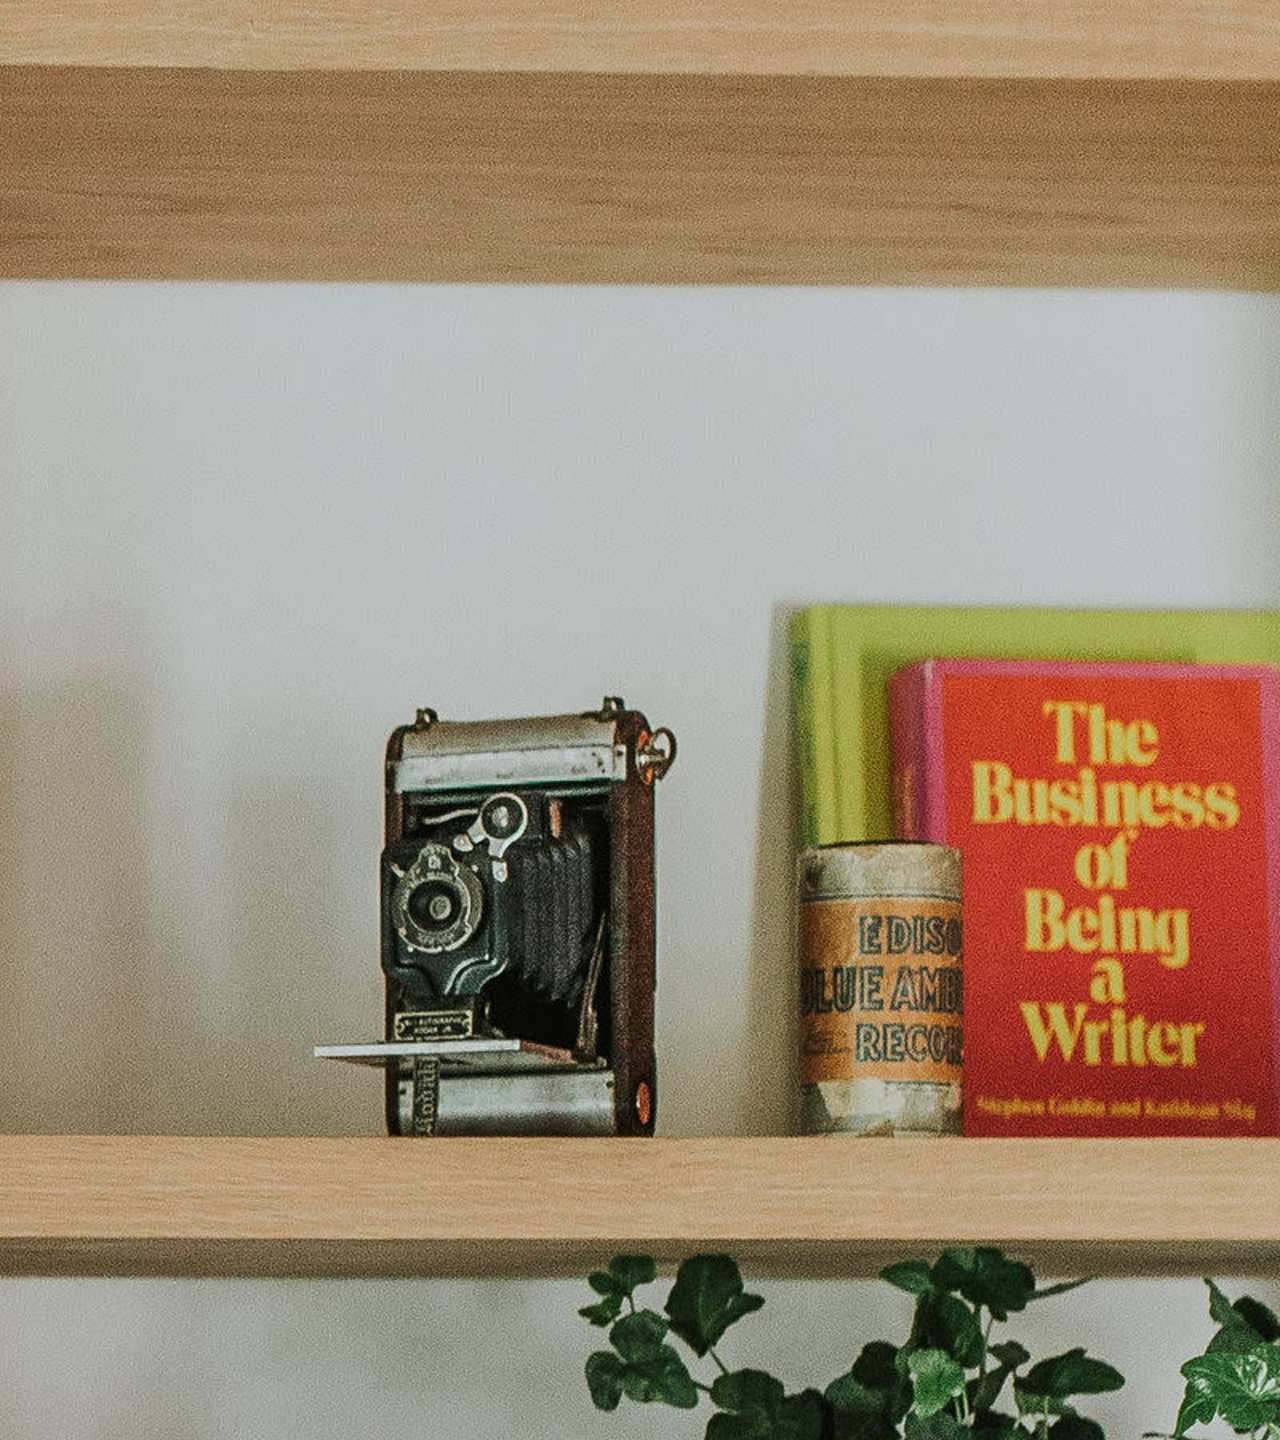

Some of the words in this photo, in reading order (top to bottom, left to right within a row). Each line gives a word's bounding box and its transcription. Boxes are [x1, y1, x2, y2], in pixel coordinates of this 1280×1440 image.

[1042, 700, 1159, 767] The
[972, 760, 1240, 831] Business
[1074, 828, 1139, 890] of
[1024, 887, 1190, 969] Being
[1088, 958, 1127, 1004] a
[1019, 1000, 1206, 1068] Writer
